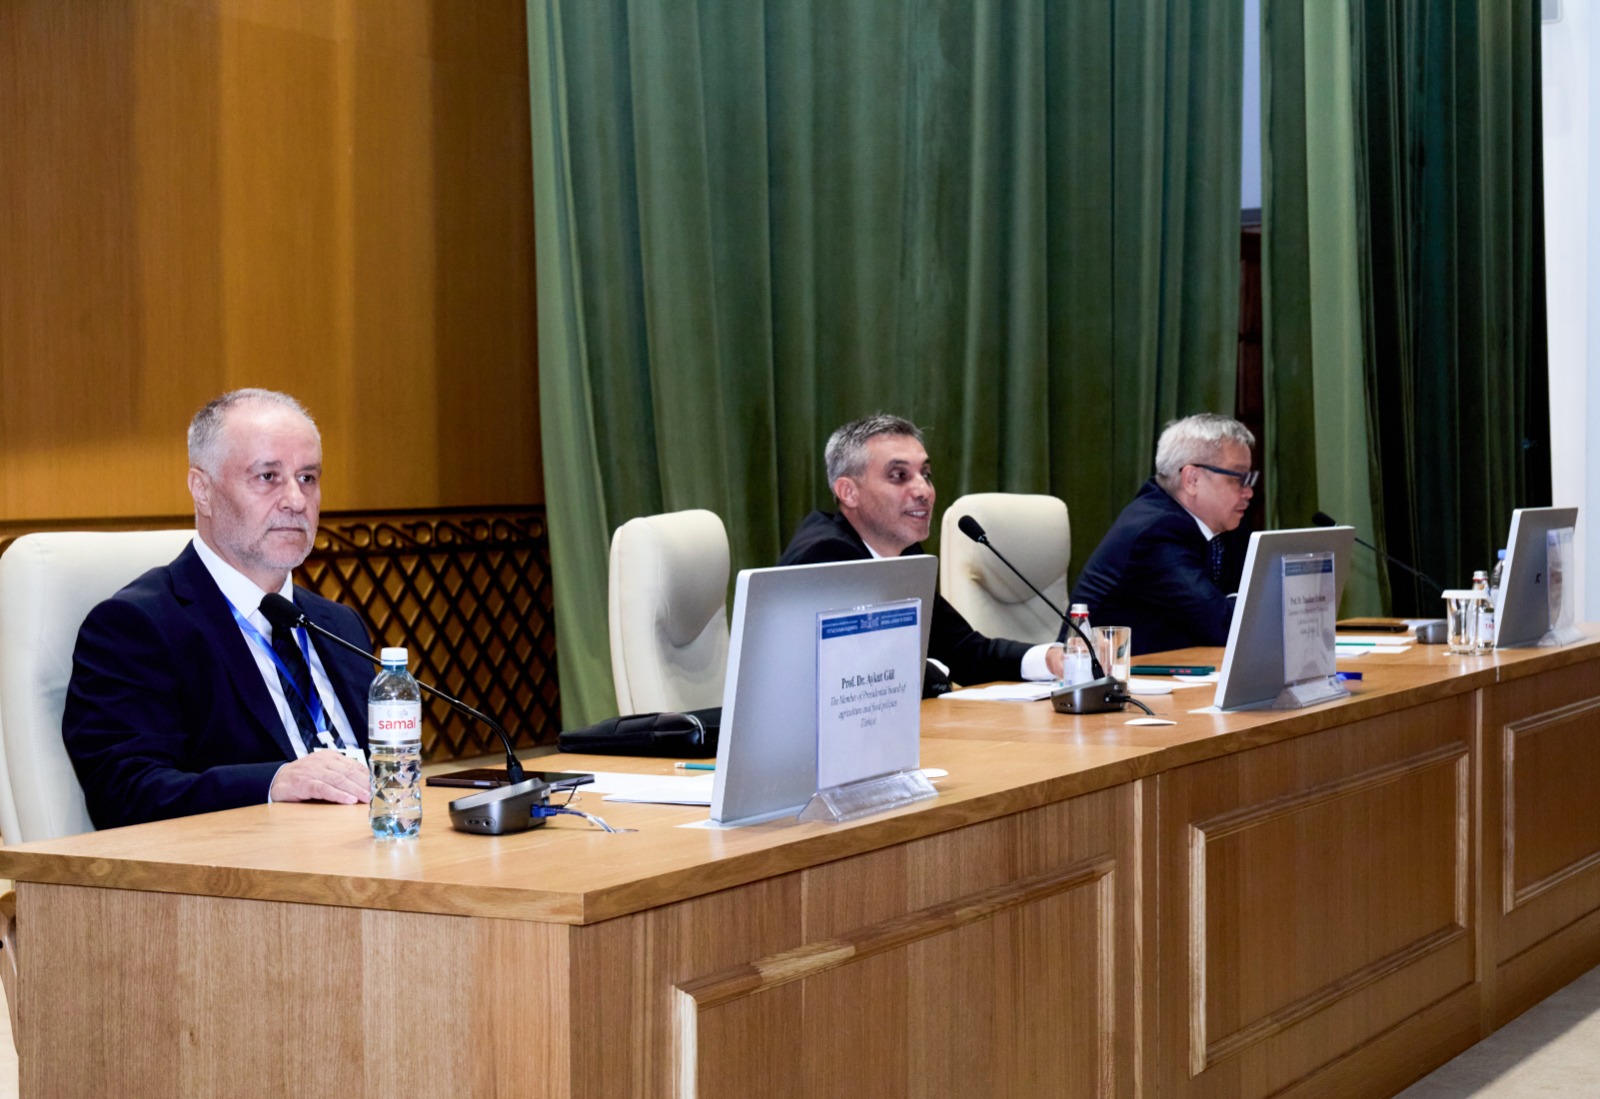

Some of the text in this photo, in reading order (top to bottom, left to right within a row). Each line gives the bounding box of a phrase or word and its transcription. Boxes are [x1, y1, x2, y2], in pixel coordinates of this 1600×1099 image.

[841, 668, 895, 689] Prof. Dr. Aykut Gül
[378, 716, 416, 730] samal
